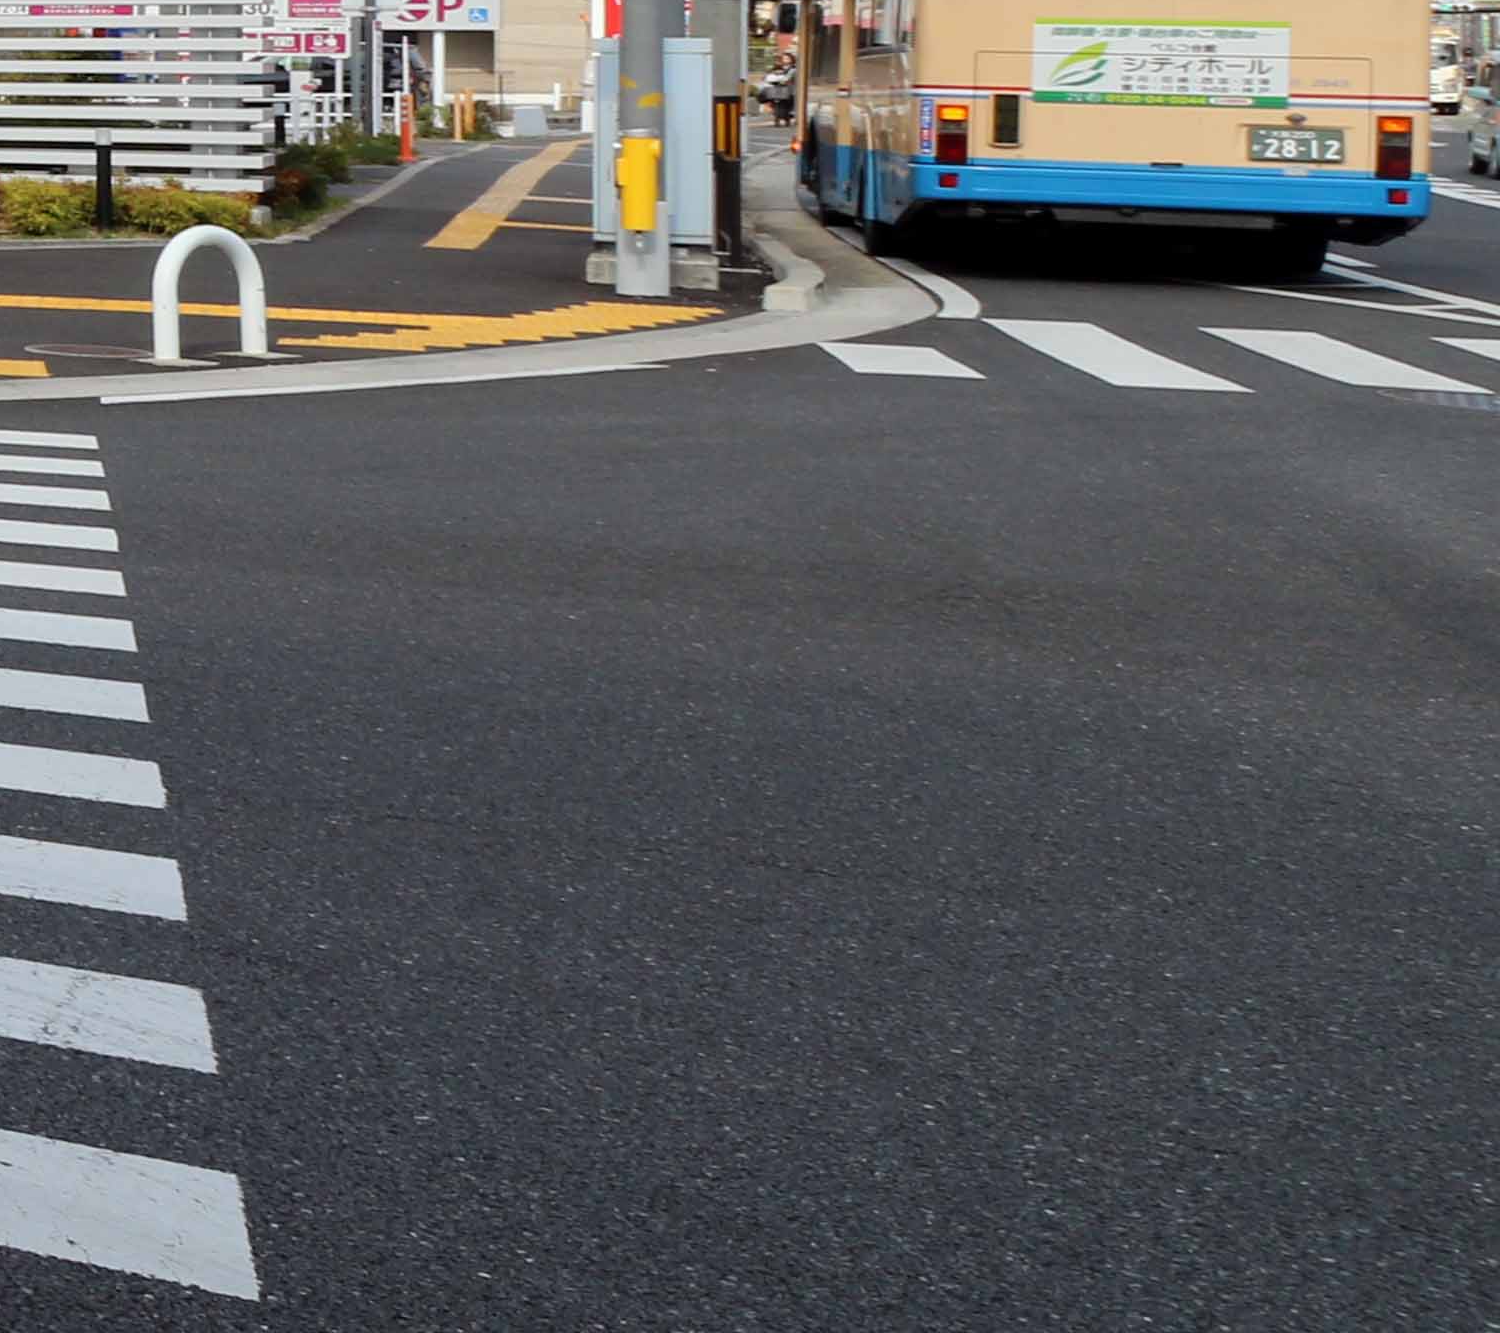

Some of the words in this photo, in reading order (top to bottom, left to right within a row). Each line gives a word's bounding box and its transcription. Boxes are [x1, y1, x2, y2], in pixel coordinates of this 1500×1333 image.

[1122, 56, 1275, 75] シティホール
[1263, 138, 1342, 160] 28-12
